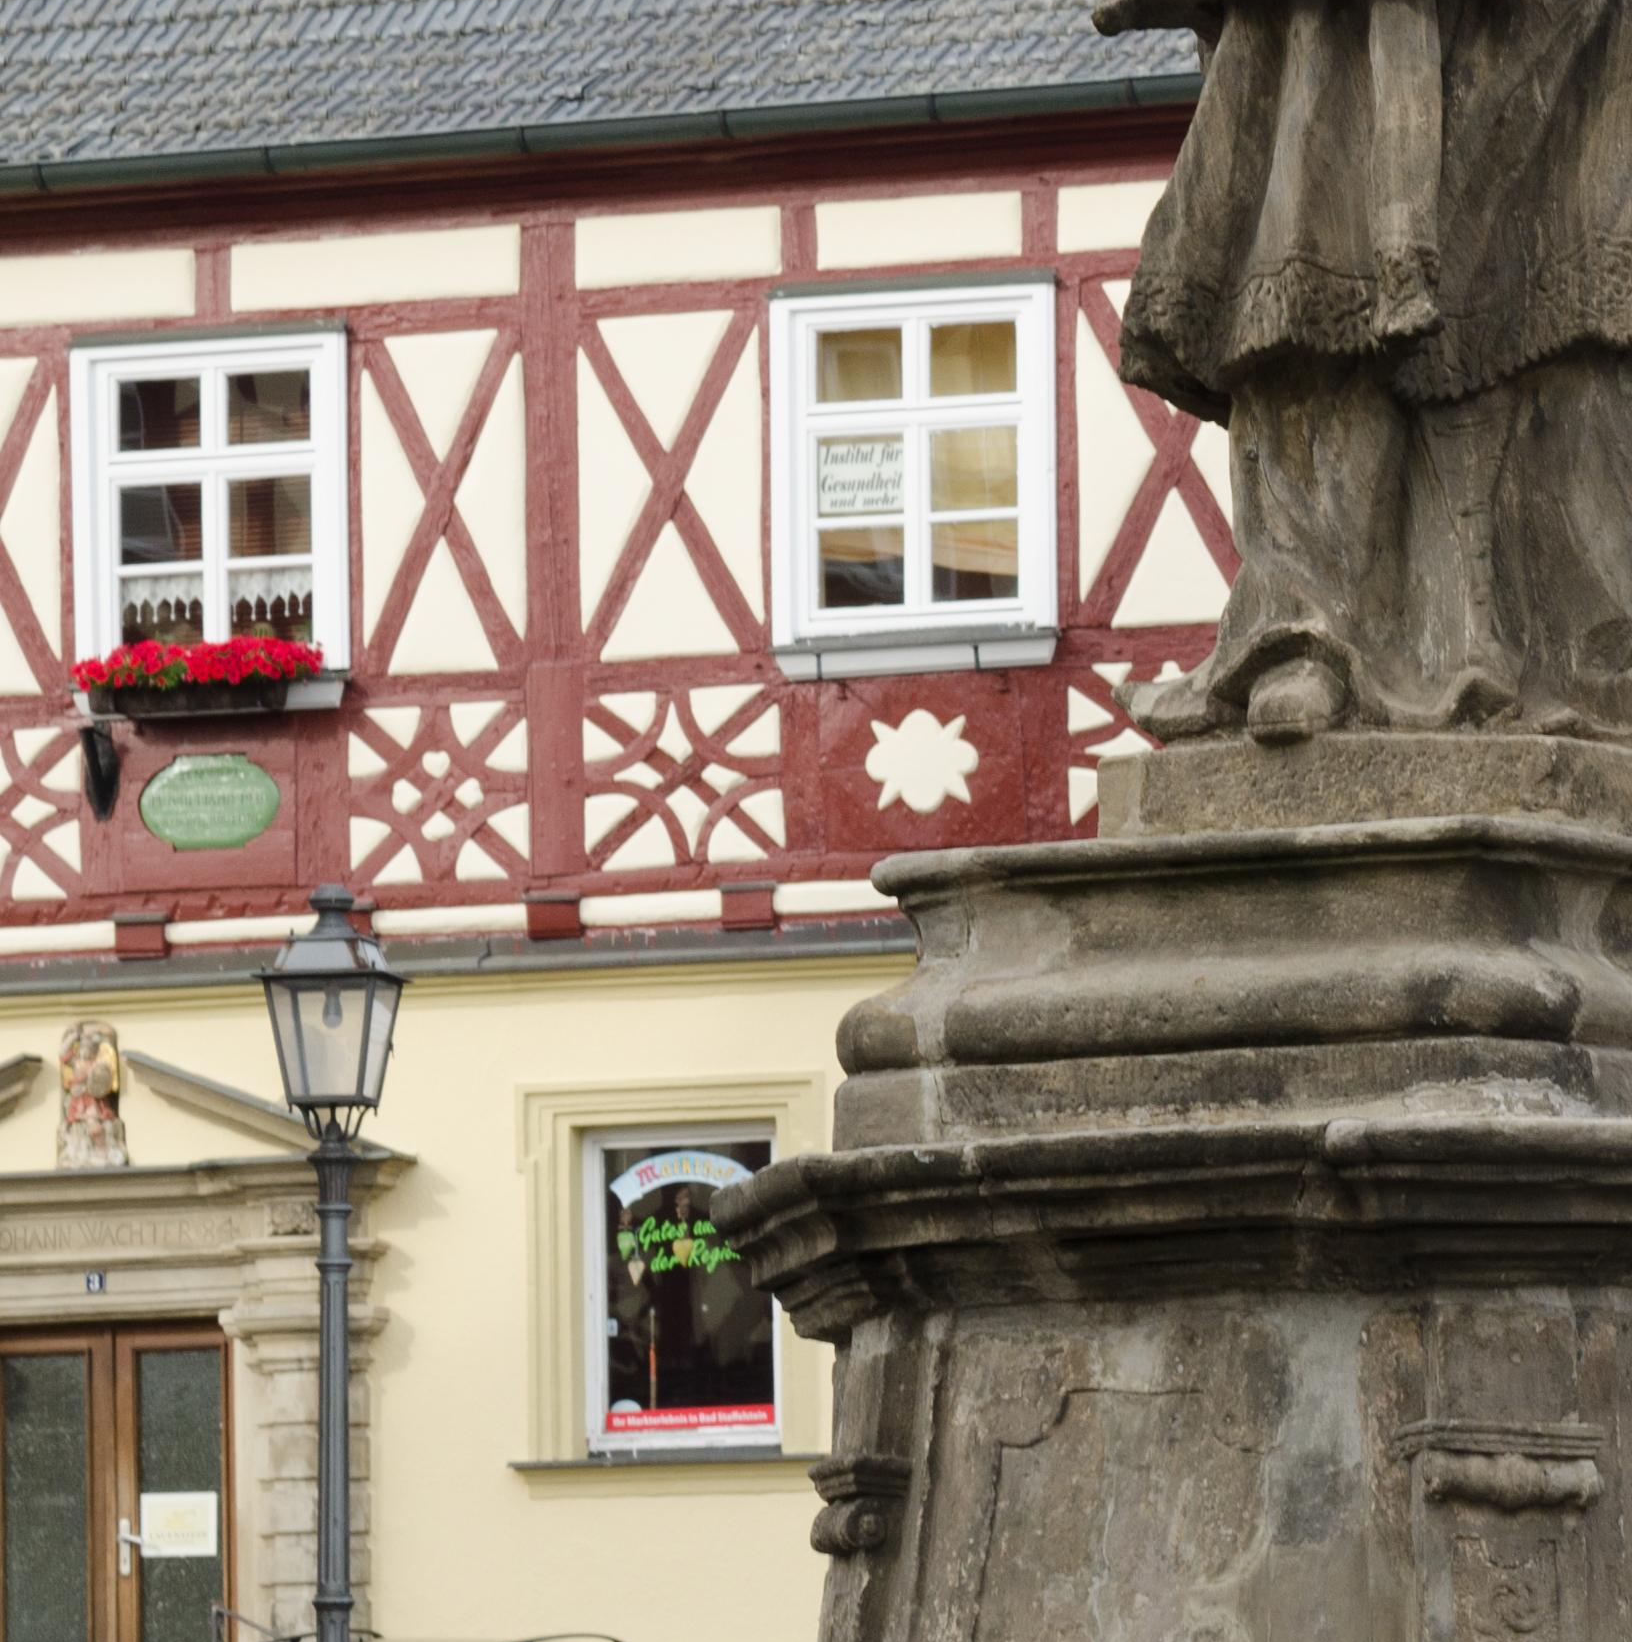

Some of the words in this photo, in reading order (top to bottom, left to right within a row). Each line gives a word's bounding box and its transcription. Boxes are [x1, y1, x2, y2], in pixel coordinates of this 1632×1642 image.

[824, 444, 875, 465] Institut
[877, 442, 903, 467] für
[821, 471, 902, 493] Gesundheit
[830, 492, 857, 507] und
[0, 1224, 72, 1252] OHANN
[639, 1215, 688, 1252] Gutes
[693, 1219, 717, 1235] au
[687, 1237, 741, 1274] Regio
